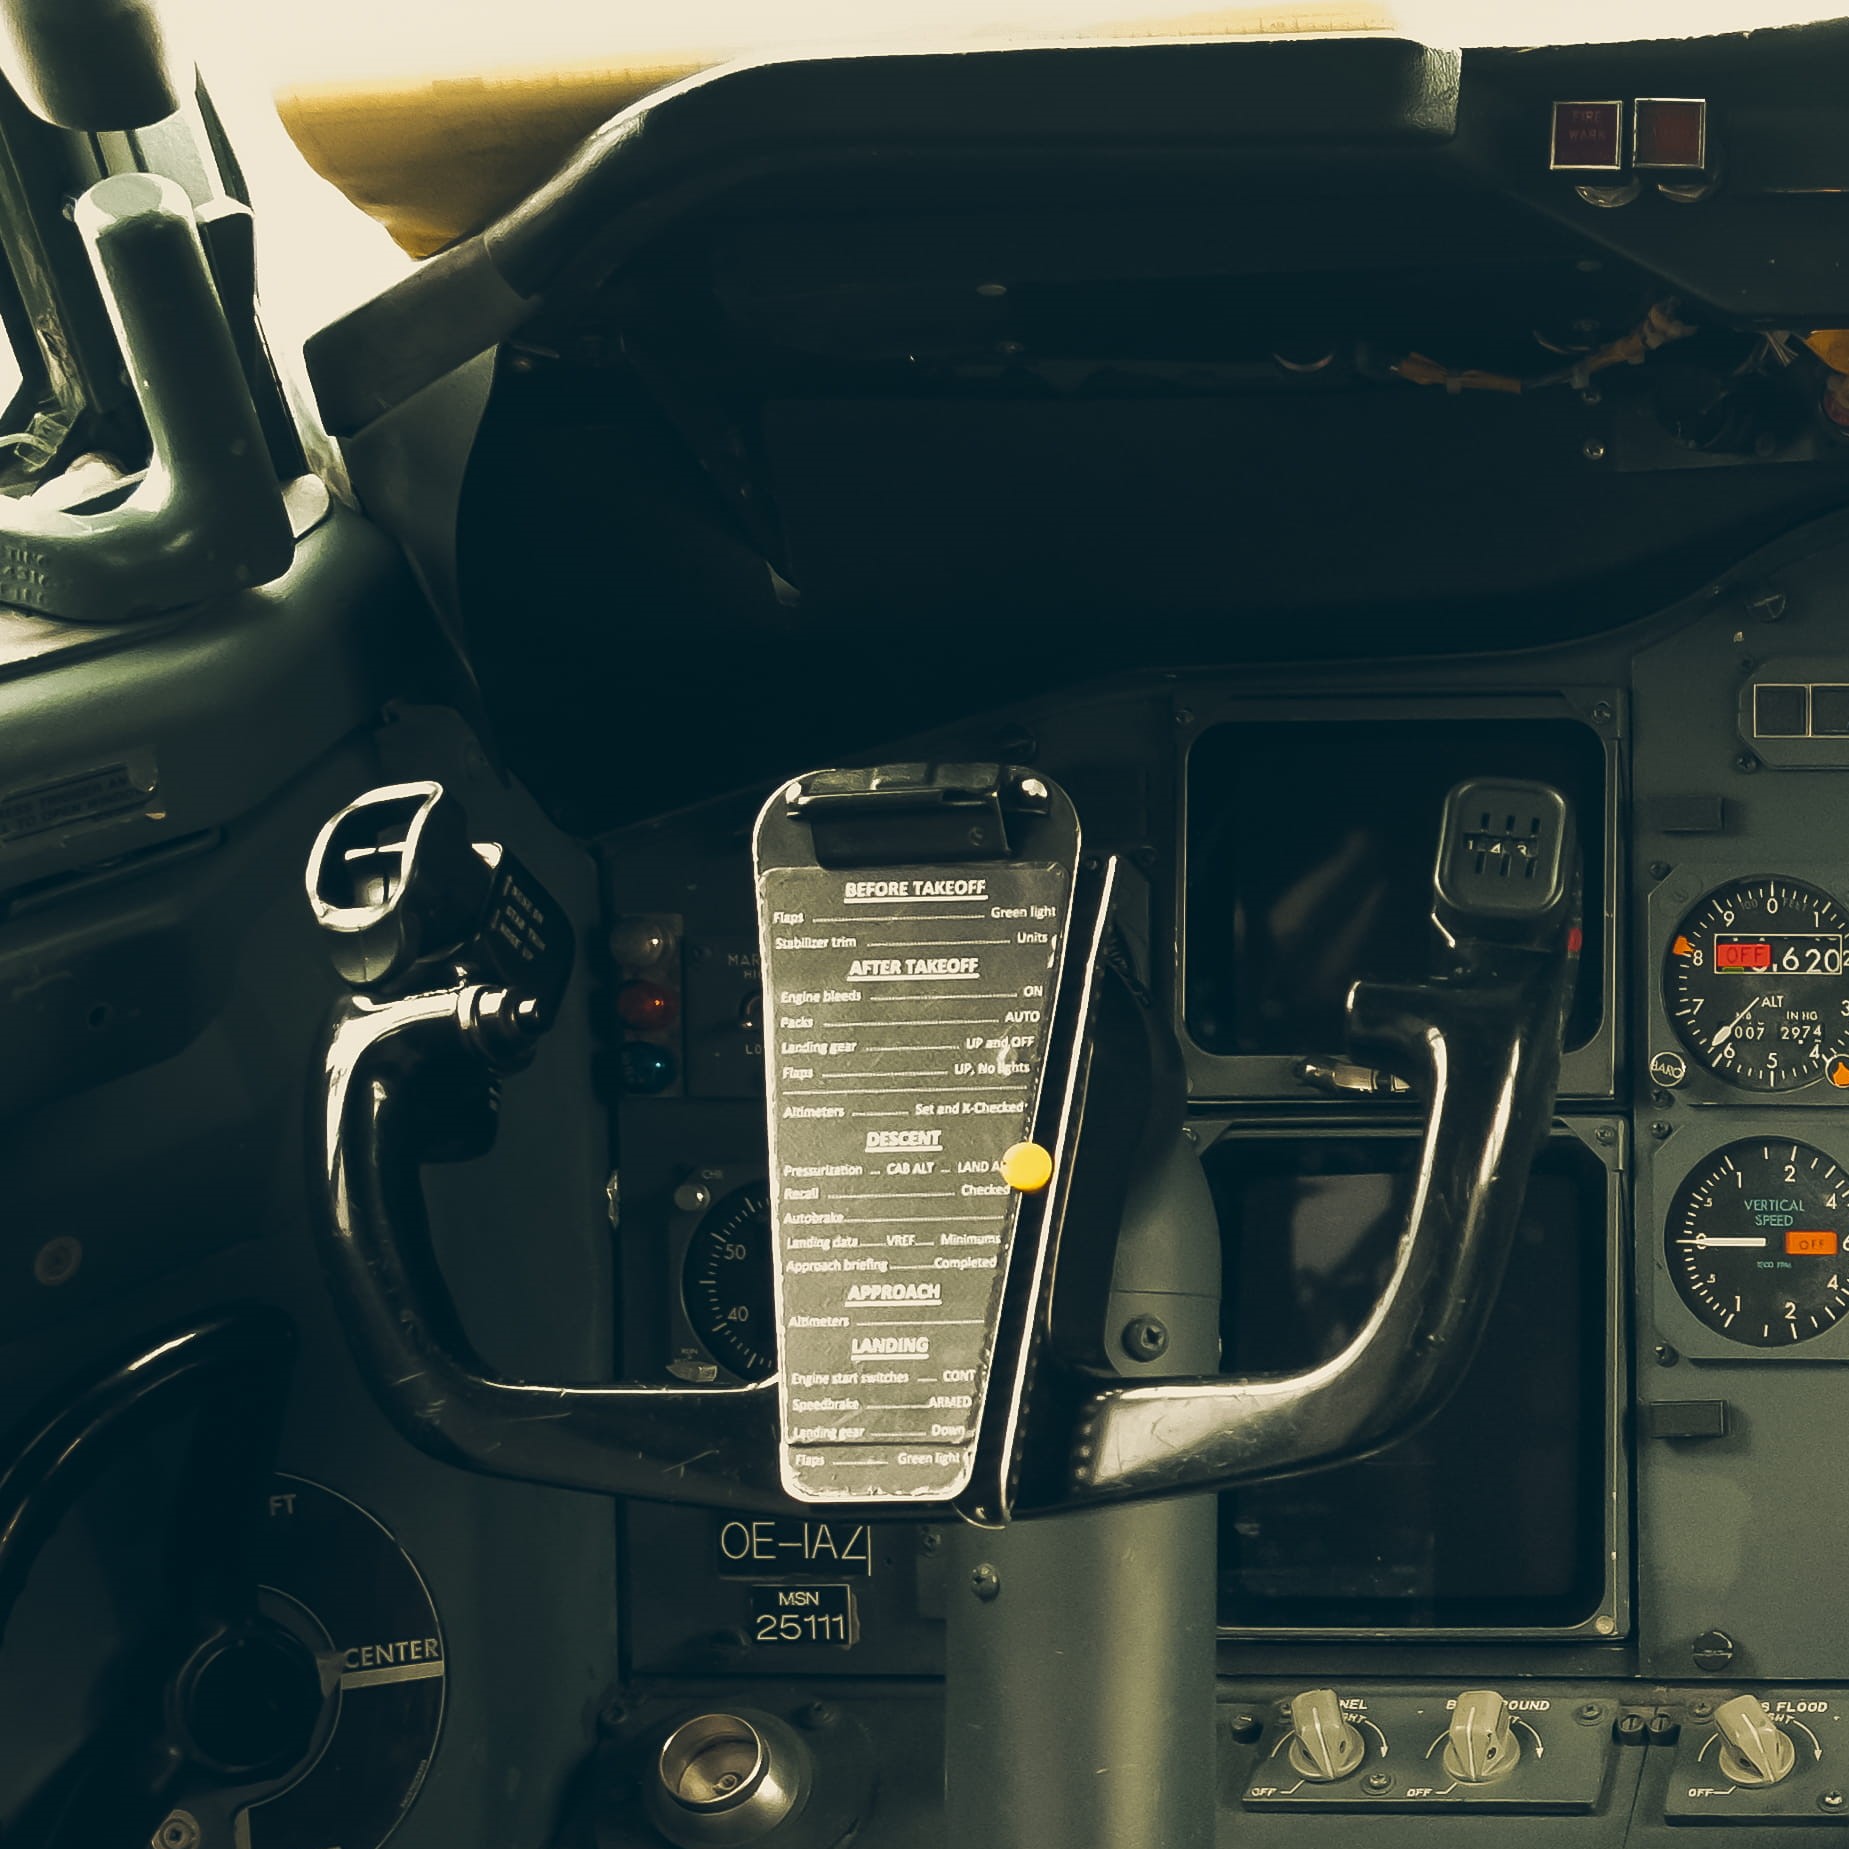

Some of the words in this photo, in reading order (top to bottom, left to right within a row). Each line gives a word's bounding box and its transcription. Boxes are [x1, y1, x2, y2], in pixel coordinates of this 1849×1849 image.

[844, 882, 909, 898] BEFORE
[913, 879, 986, 896] TAKEOFF
[991, 907, 1027, 918] Green
[1030, 905, 1056, 920] light
[1017, 932, 1048, 943] Units
[850, 960, 901, 976] AFTER
[905, 958, 979, 975] TAKEOFF
[1005, 1011, 1040, 1022] AUTO
[867, 1130, 941, 1147] DESCENT
[1744, 1199, 1805, 1212] VERTICAL
[1755, 1214, 1793, 1226] SPEED
[847, 1284, 941, 1301] APPROACH
[852, 1337, 929, 1353] LANDING
[779, 1592, 819, 1606] MSN
[757, 1616, 845, 1640] 25111
[344, 1638, 440, 1669] CENTER
